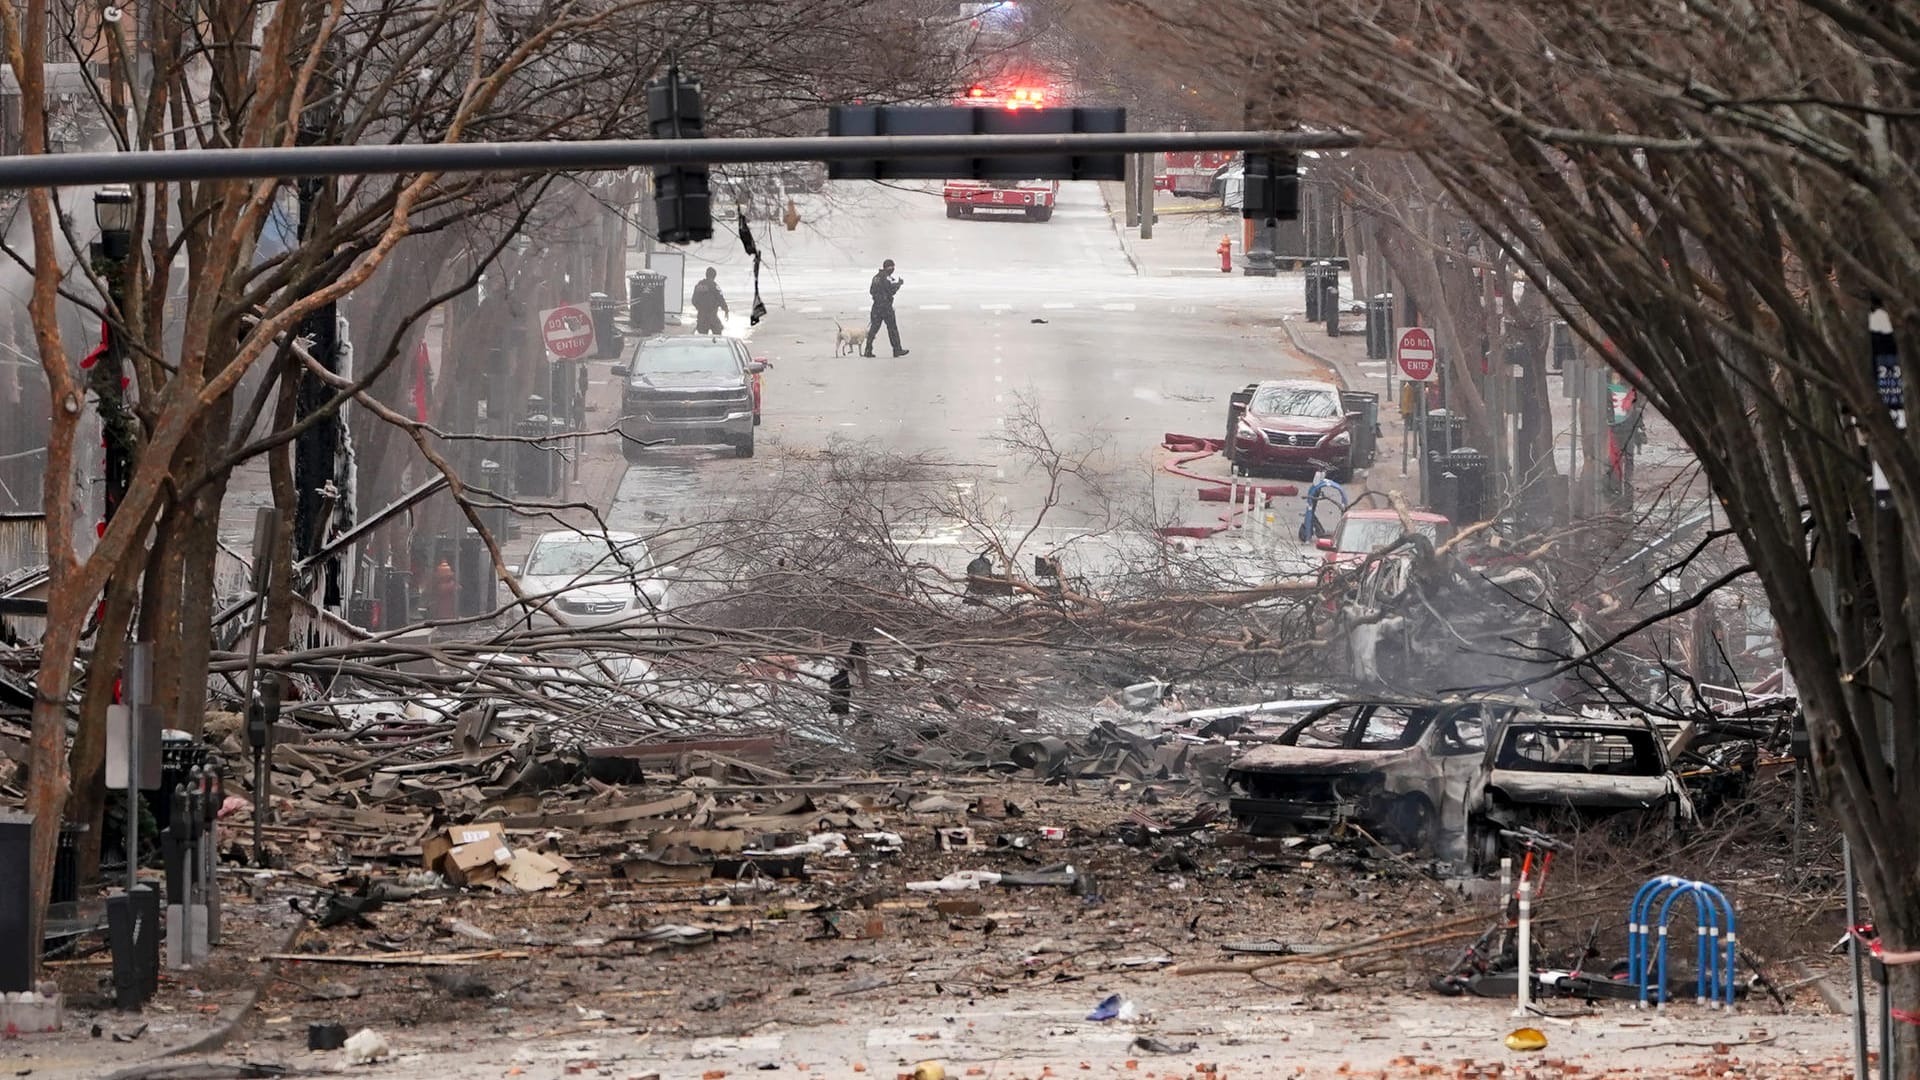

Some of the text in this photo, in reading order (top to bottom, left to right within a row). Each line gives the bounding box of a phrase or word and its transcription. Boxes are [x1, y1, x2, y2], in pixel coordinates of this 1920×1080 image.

[548, 319, 561, 330] DO
[556, 338, 586, 351] ENTER
[1403, 338, 1431, 348] DO NOT
[1407, 360, 1430, 370] ENTER
